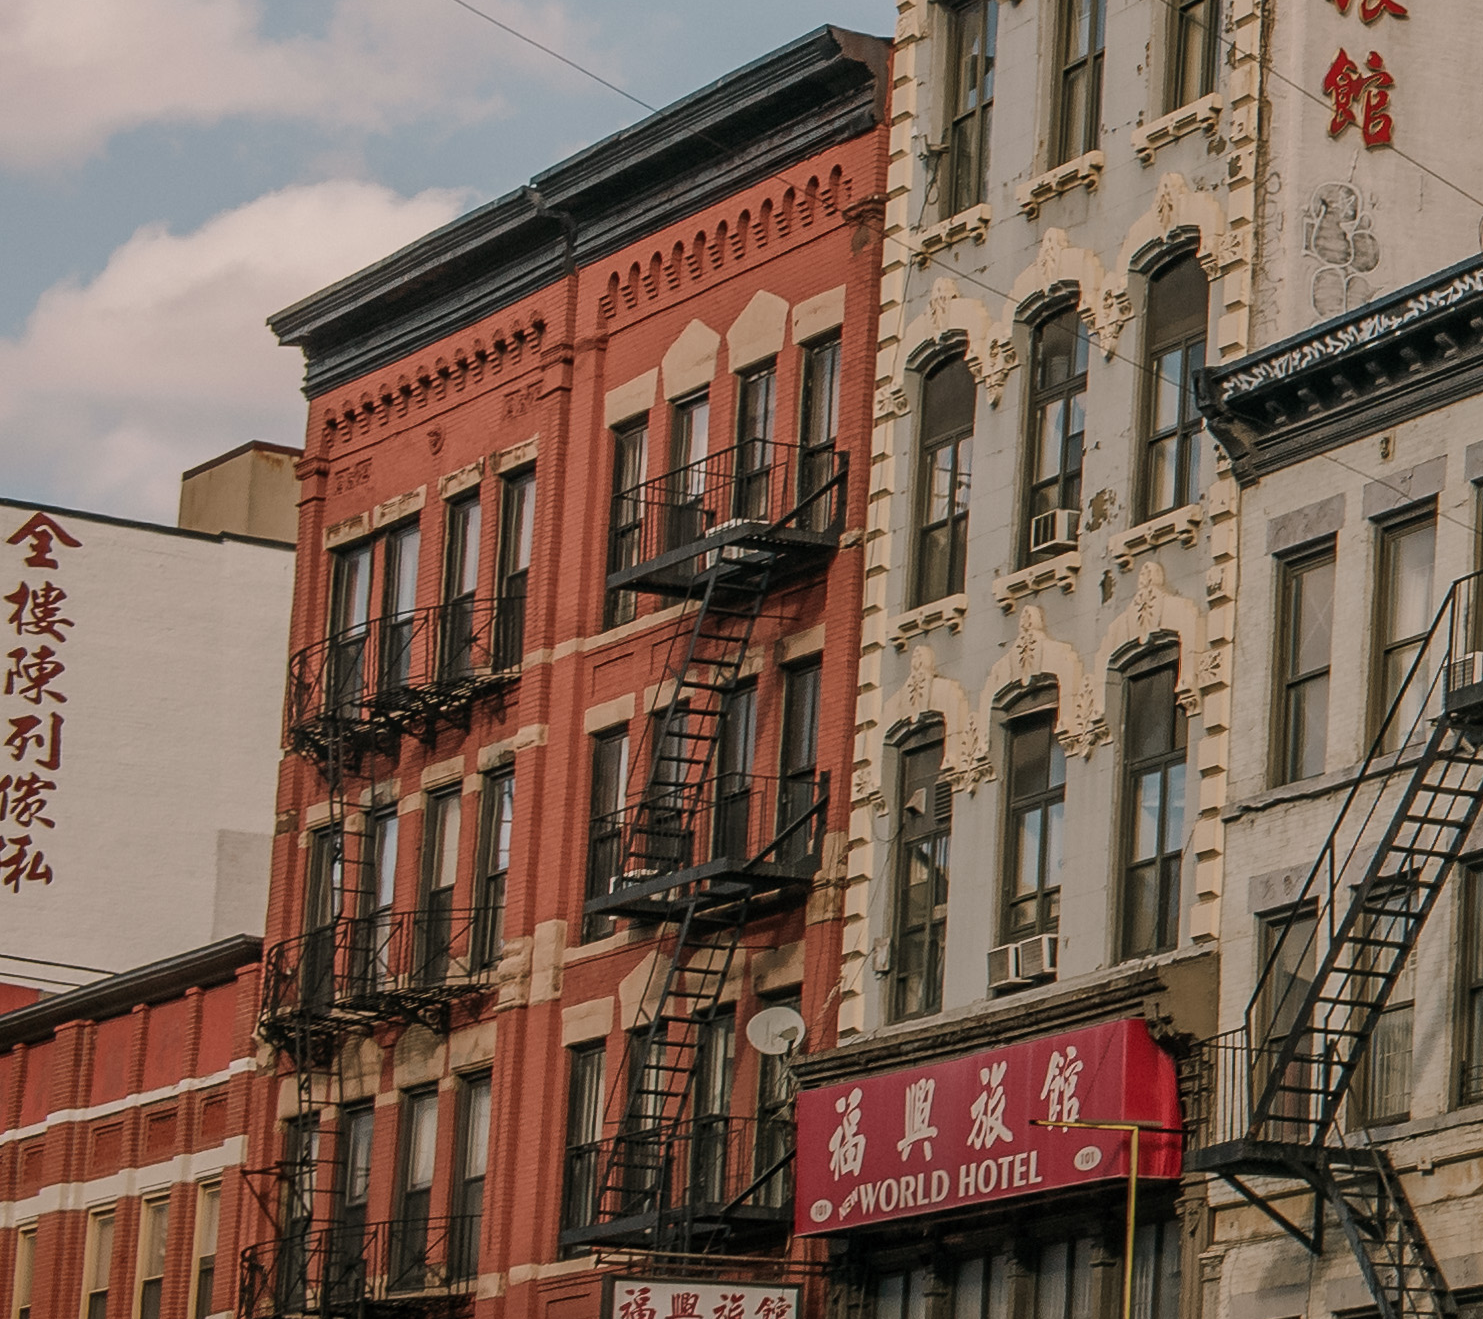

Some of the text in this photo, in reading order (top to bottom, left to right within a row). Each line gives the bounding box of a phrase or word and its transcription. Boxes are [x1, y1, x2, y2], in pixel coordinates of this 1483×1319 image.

[828, 1046, 1085, 1182] 福興旅館
[858, 1168, 950, 1216] WORLD
[957, 1149, 1043, 1199] HOTEL
